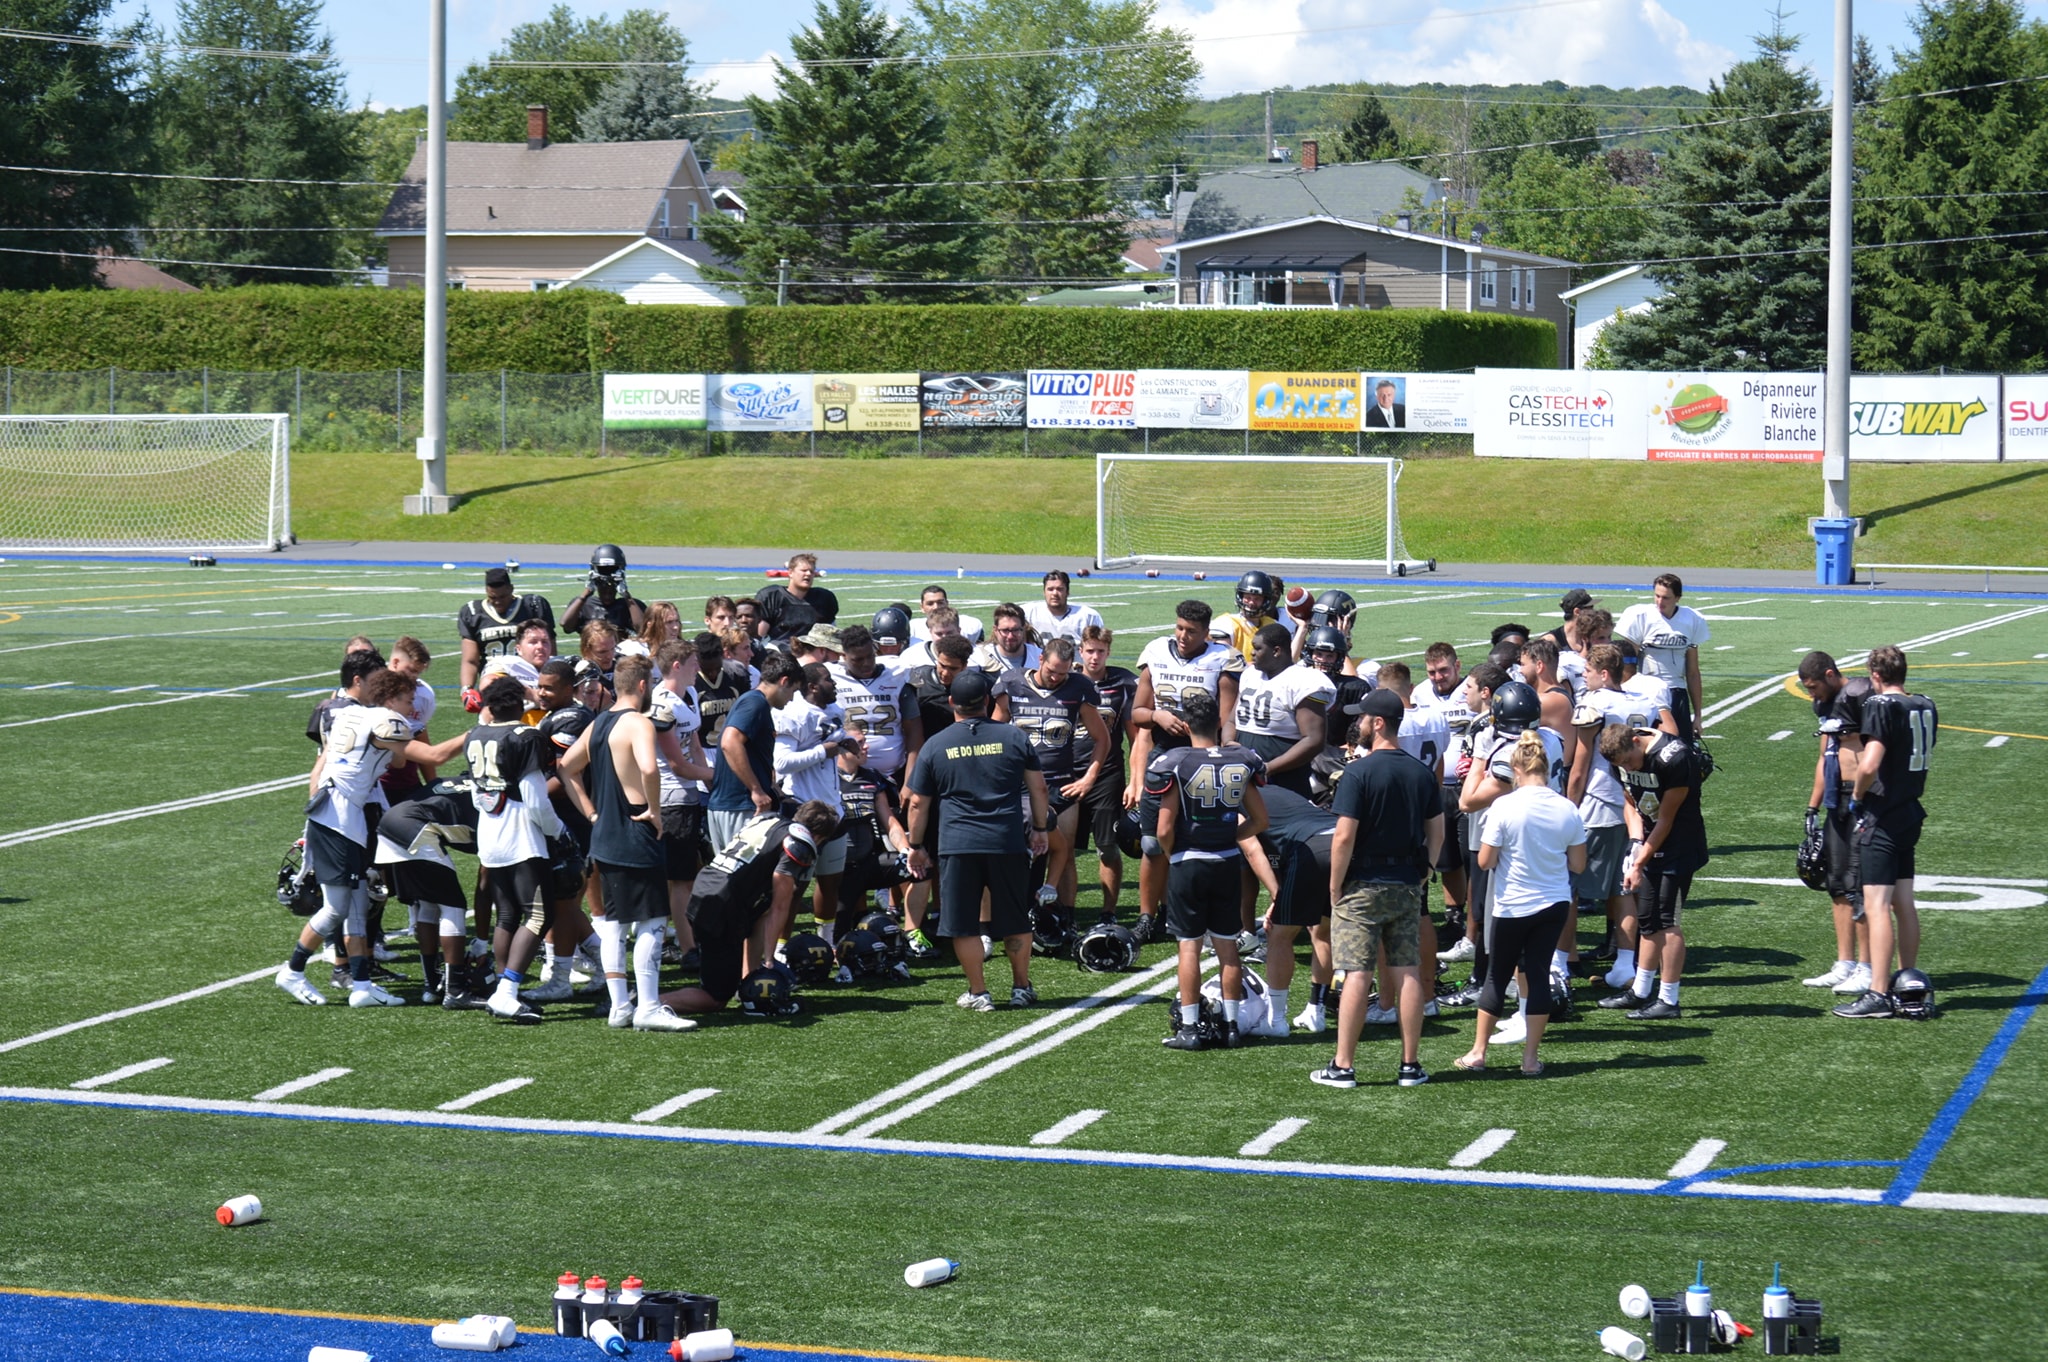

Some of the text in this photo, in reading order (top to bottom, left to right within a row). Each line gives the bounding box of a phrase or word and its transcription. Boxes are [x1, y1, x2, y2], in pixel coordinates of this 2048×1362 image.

[1031, 373, 1135, 396] VITRO PLUS
[1154, 378, 1216, 387] CONSTRUCTIONS
[1287, 378, 1356, 387] BUANDERIE
[1510, 385, 1540, 393] GROUPE
[1743, 380, 1816, 401] Dépanneur
[611, 389, 701, 405] VERTDURE
[859, 386, 918, 396] LES HALLES
[1508, 394, 1587, 410] CASTECH
[1771, 402, 1816, 420] Rivière
[1030, 418, 1136, 427] 418.334.0415
[1508, 412, 1614, 427] PLESSITECH
[1765, 424, 1816, 442] Blanche
[1656, 451, 1700, 459] SPÉCIALISTE
[1713, 452, 1738, 460] BIÈRES
[1159, 673, 1205, 684] THETFORD
[845, 694, 891, 704] THETFORD
[1018, 706, 1069, 717] THETFORD
[1237, 687, 1273, 728] 50
[388, 718, 404, 736] T
[1013, 716, 1073, 749] 50
[1909, 710, 1934, 771] 11
[946, 747, 960, 760] WE
[960, 746, 972, 757] DO
[1184, 763, 1251, 808] 48
[755, 979, 777, 998] T
